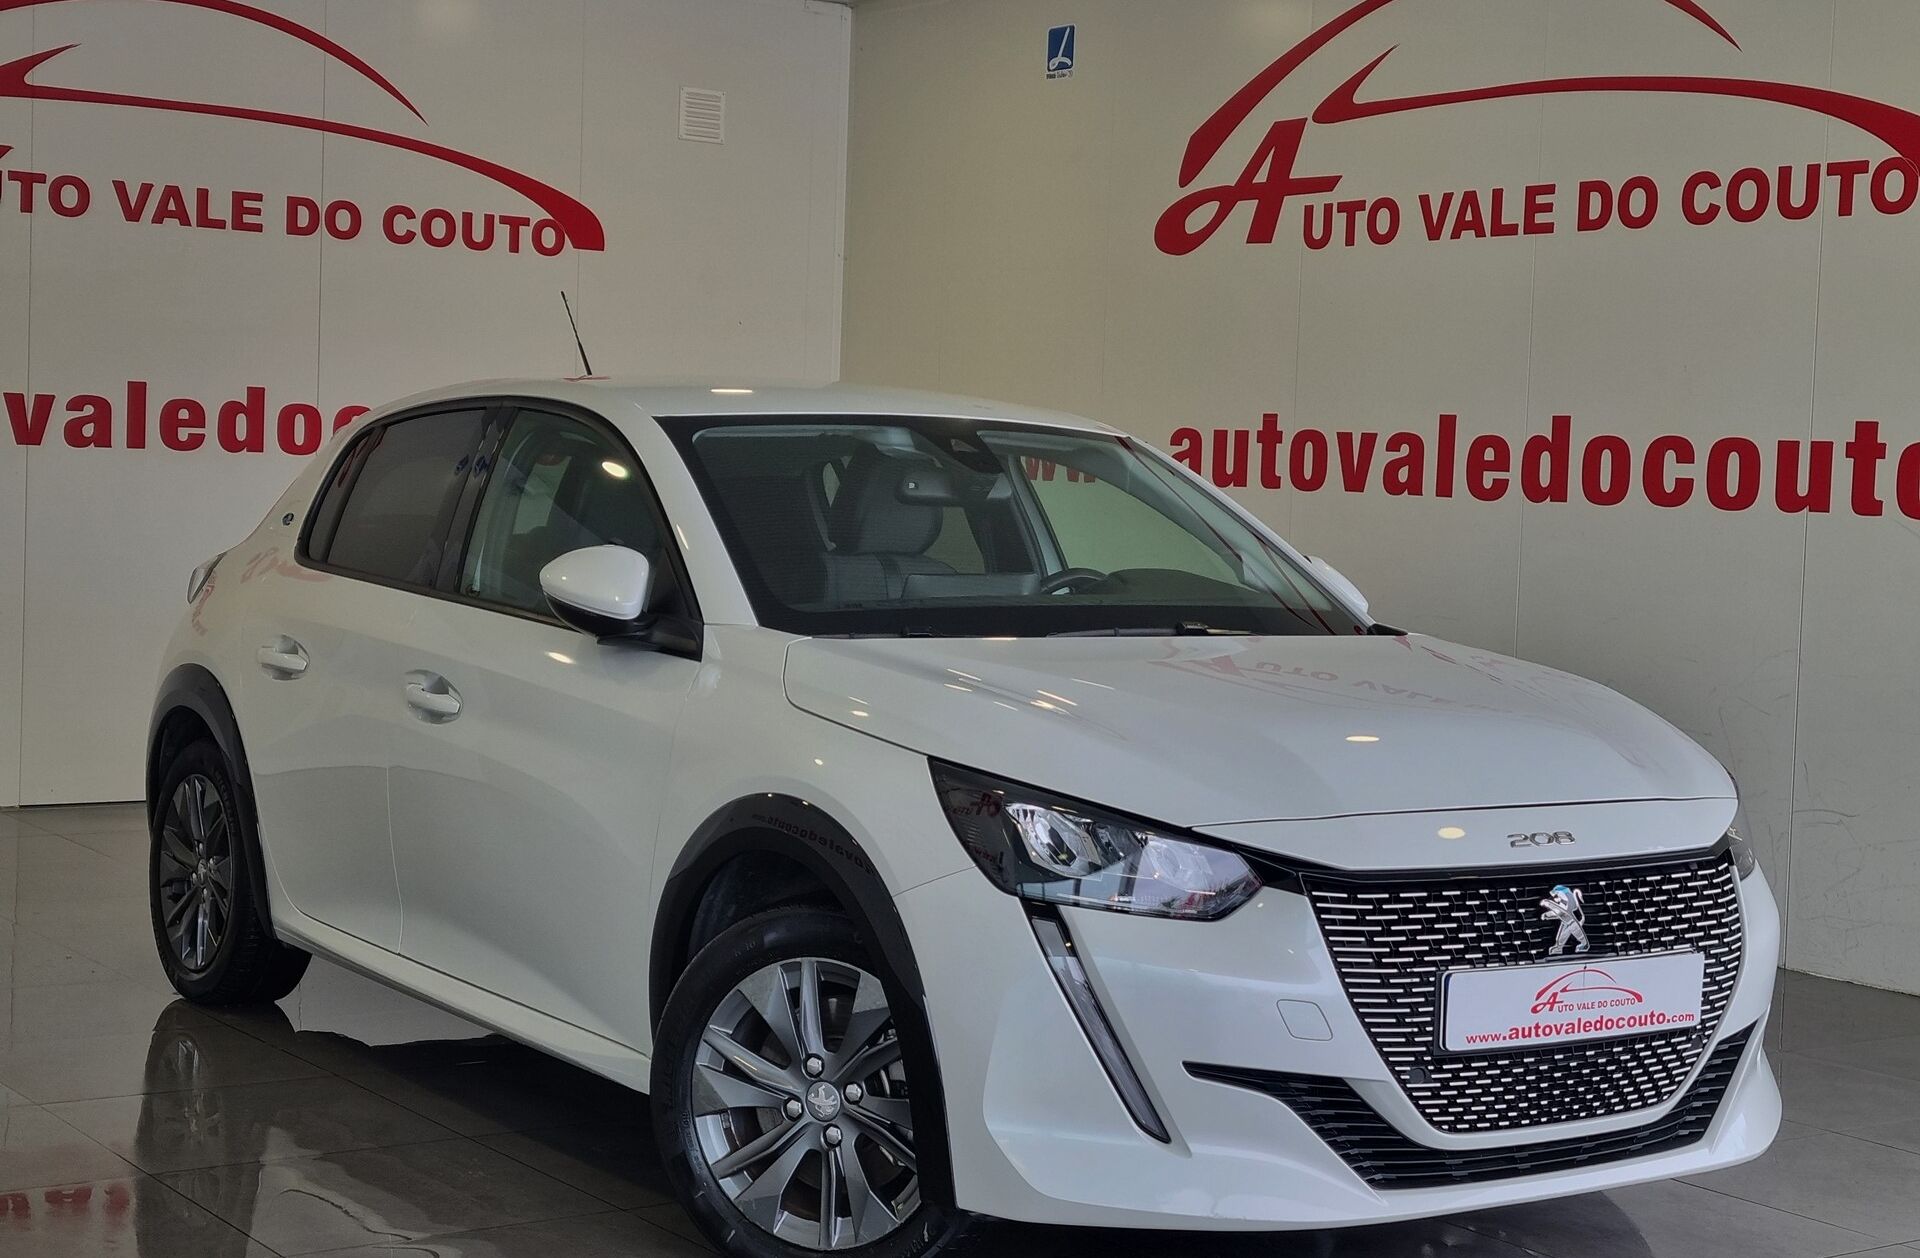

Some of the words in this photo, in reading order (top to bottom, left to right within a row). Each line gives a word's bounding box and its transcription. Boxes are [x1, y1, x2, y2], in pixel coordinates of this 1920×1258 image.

[1154, 117, 1401, 256] AUTO
[1418, 182, 1557, 241] VALE
[1576, 174, 1659, 233] DO
[1681, 155, 1919, 226] COUTO
[0, 169, 91, 218] TO
[113, 179, 264, 233] VALE
[285, 195, 363, 240] DO
[382, 203, 566, 257] COUTO
[1507, 831, 1576, 848] 208
[1577, 1001, 1595, 1011] VALE
[1597, 1000, 1608, 1008] DO
[1610, 997, 1636, 1007] COUTO
[1466, 1010, 1695, 1044] www.autovaledocouto.com
